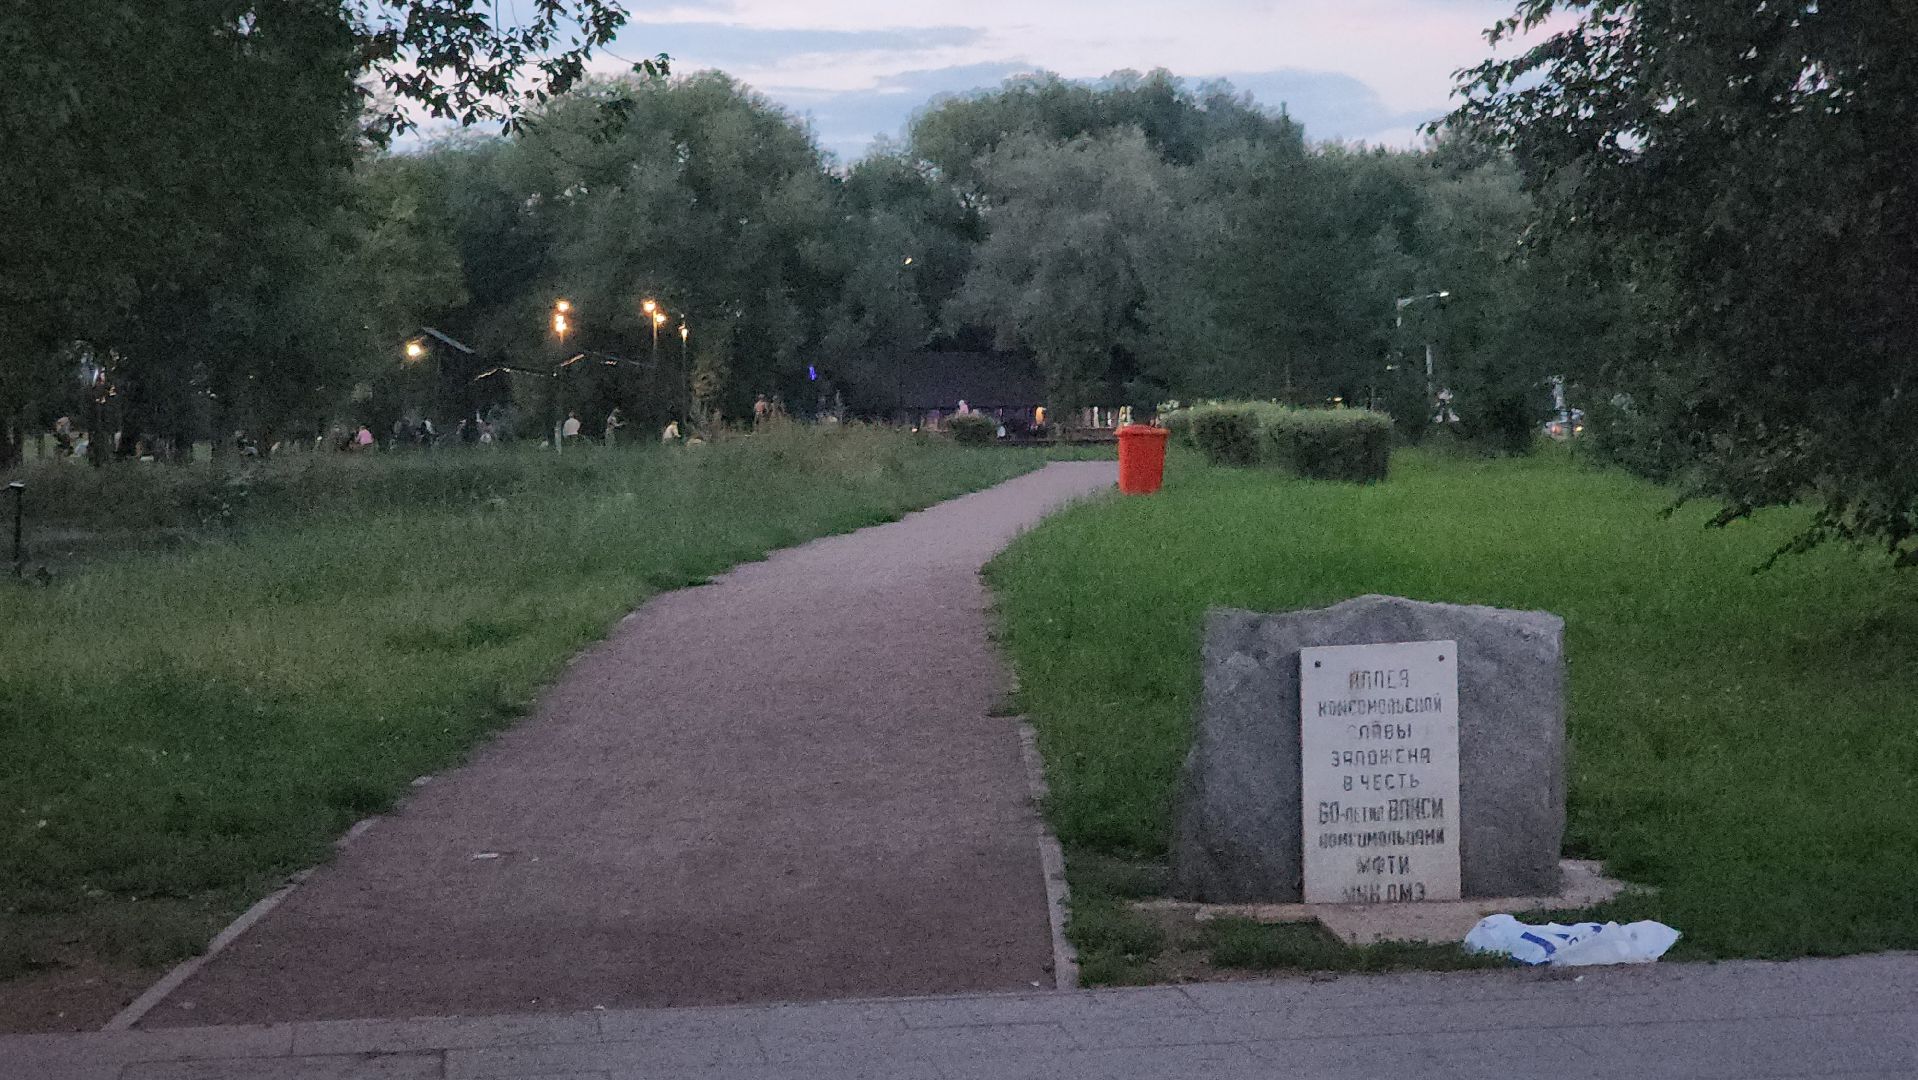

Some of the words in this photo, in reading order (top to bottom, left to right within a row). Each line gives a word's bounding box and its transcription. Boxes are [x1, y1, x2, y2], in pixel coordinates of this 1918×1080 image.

[1349, 668, 1410, 690] АЛЛЕЯ
[1317, 692, 1442, 717] КОМСОМОЛЬСКОЙ
[1331, 747, 1431, 767] ЗАЛОЖЕНА
[1343, 775, 1353, 791] В
[1360, 773, 1420, 790] ЧЕСТЬ
[1388, 797, 1444, 821] ВЛКСМ
